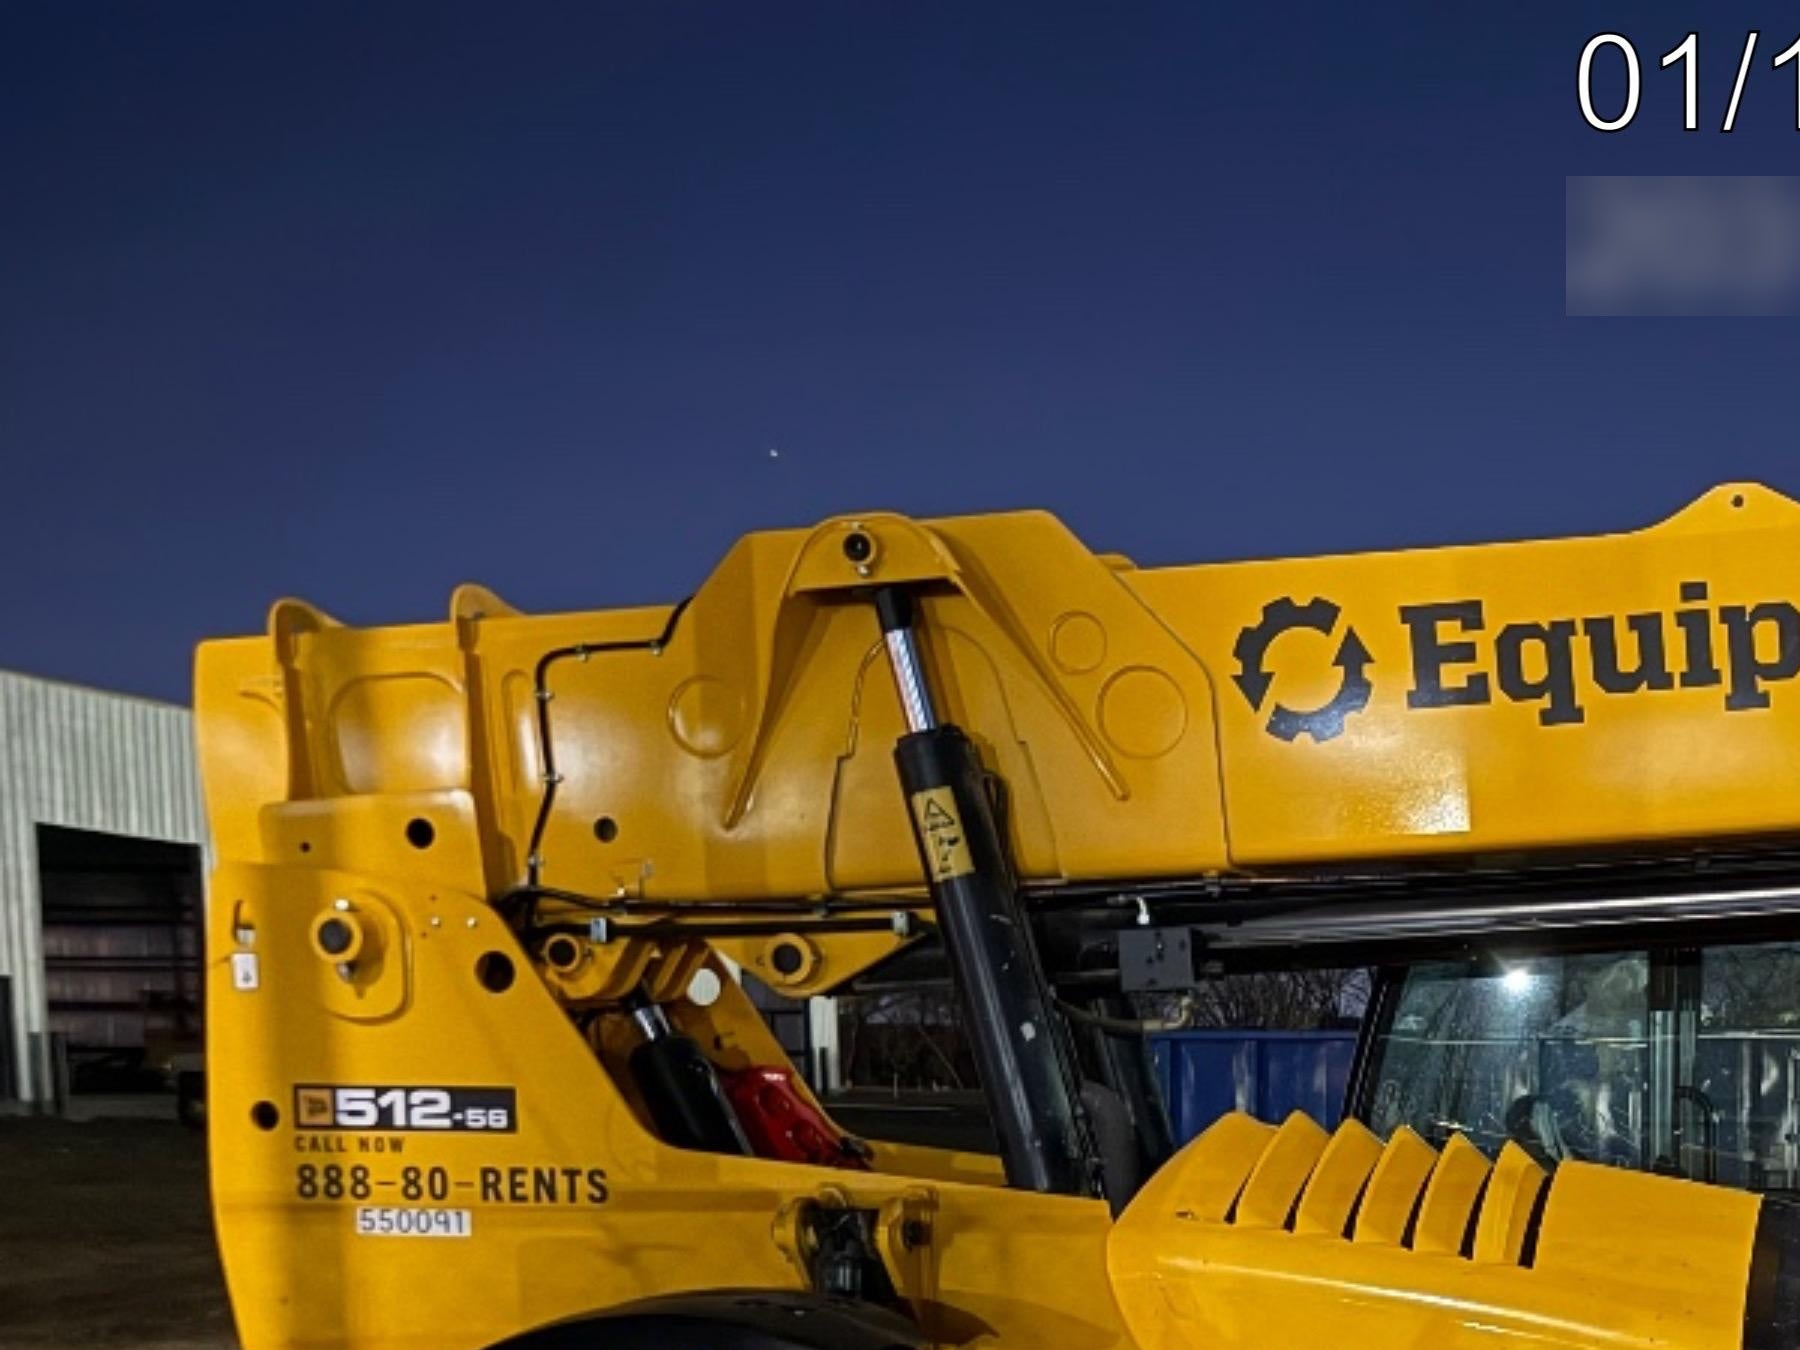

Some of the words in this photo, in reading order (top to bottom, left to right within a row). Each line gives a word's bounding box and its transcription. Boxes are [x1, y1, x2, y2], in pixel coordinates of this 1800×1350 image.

[336, 1088, 508, 1129] 512-56
[295, 1136, 347, 1153] CALL
[358, 1137, 405, 1153] NOW
[296, 1163, 609, 1204] 888-80-RENTS
[359, 1208, 465, 1234] 550091
